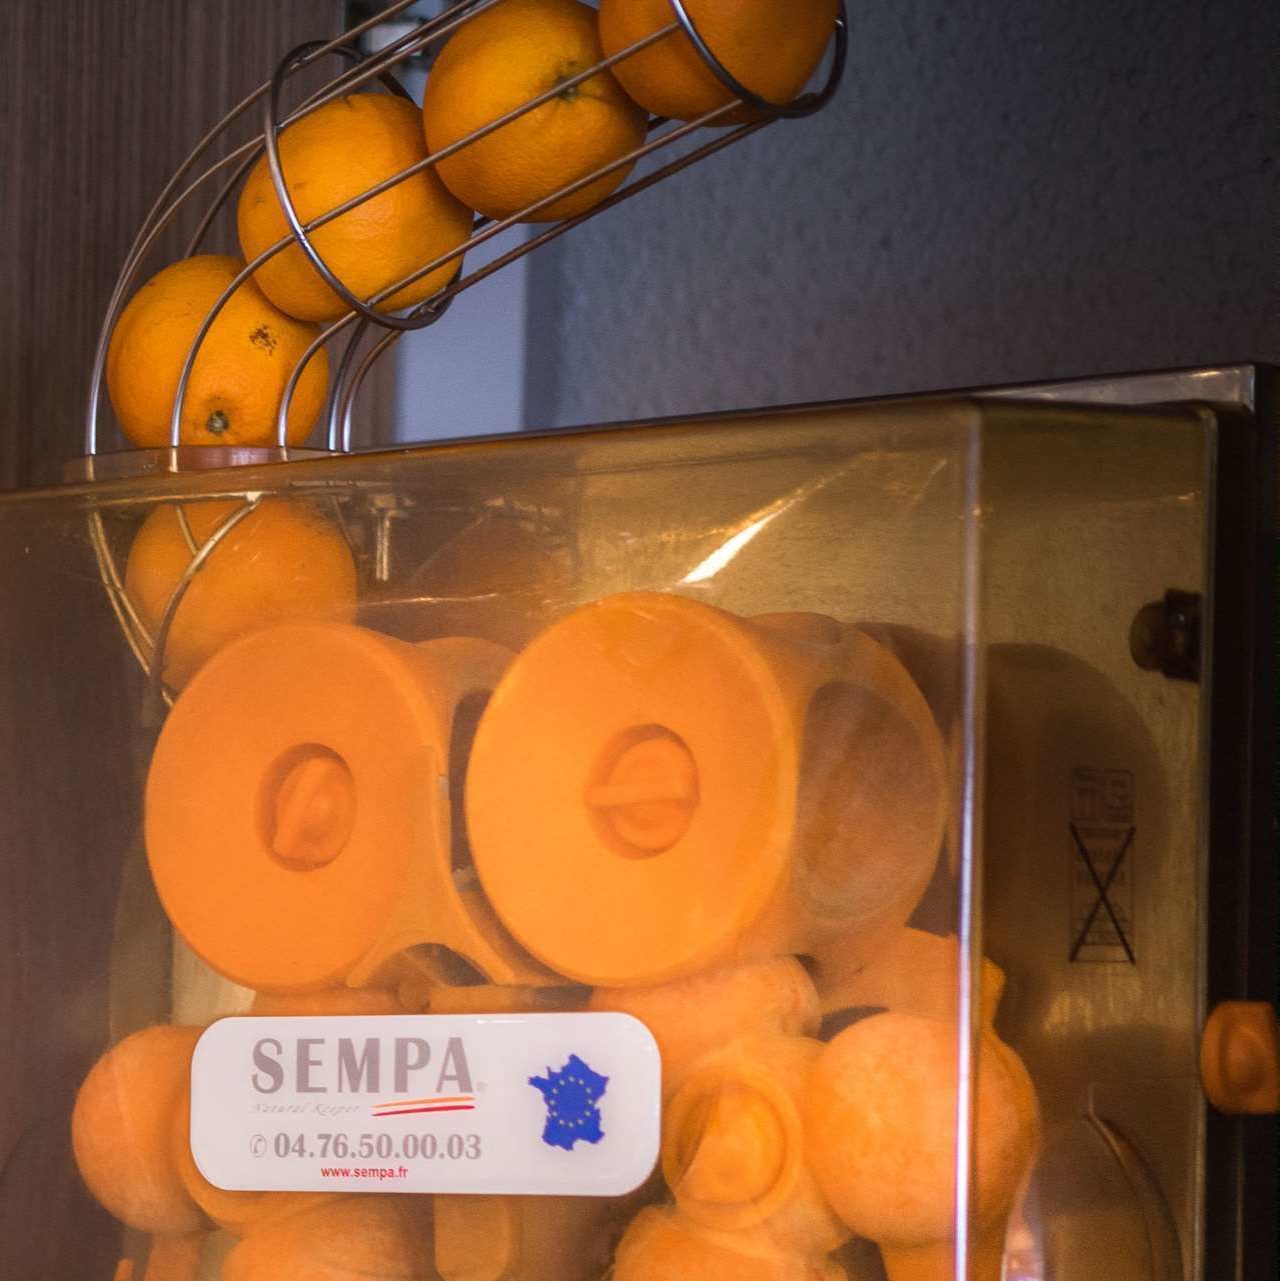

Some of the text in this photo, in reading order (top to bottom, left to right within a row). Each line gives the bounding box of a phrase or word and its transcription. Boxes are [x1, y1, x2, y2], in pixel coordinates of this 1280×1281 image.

[251, 1036, 474, 1095] SEMPA
[273, 1132, 482, 1159] 04.76.50.00.03
[320, 1165, 409, 1181] www.sempa.fr
